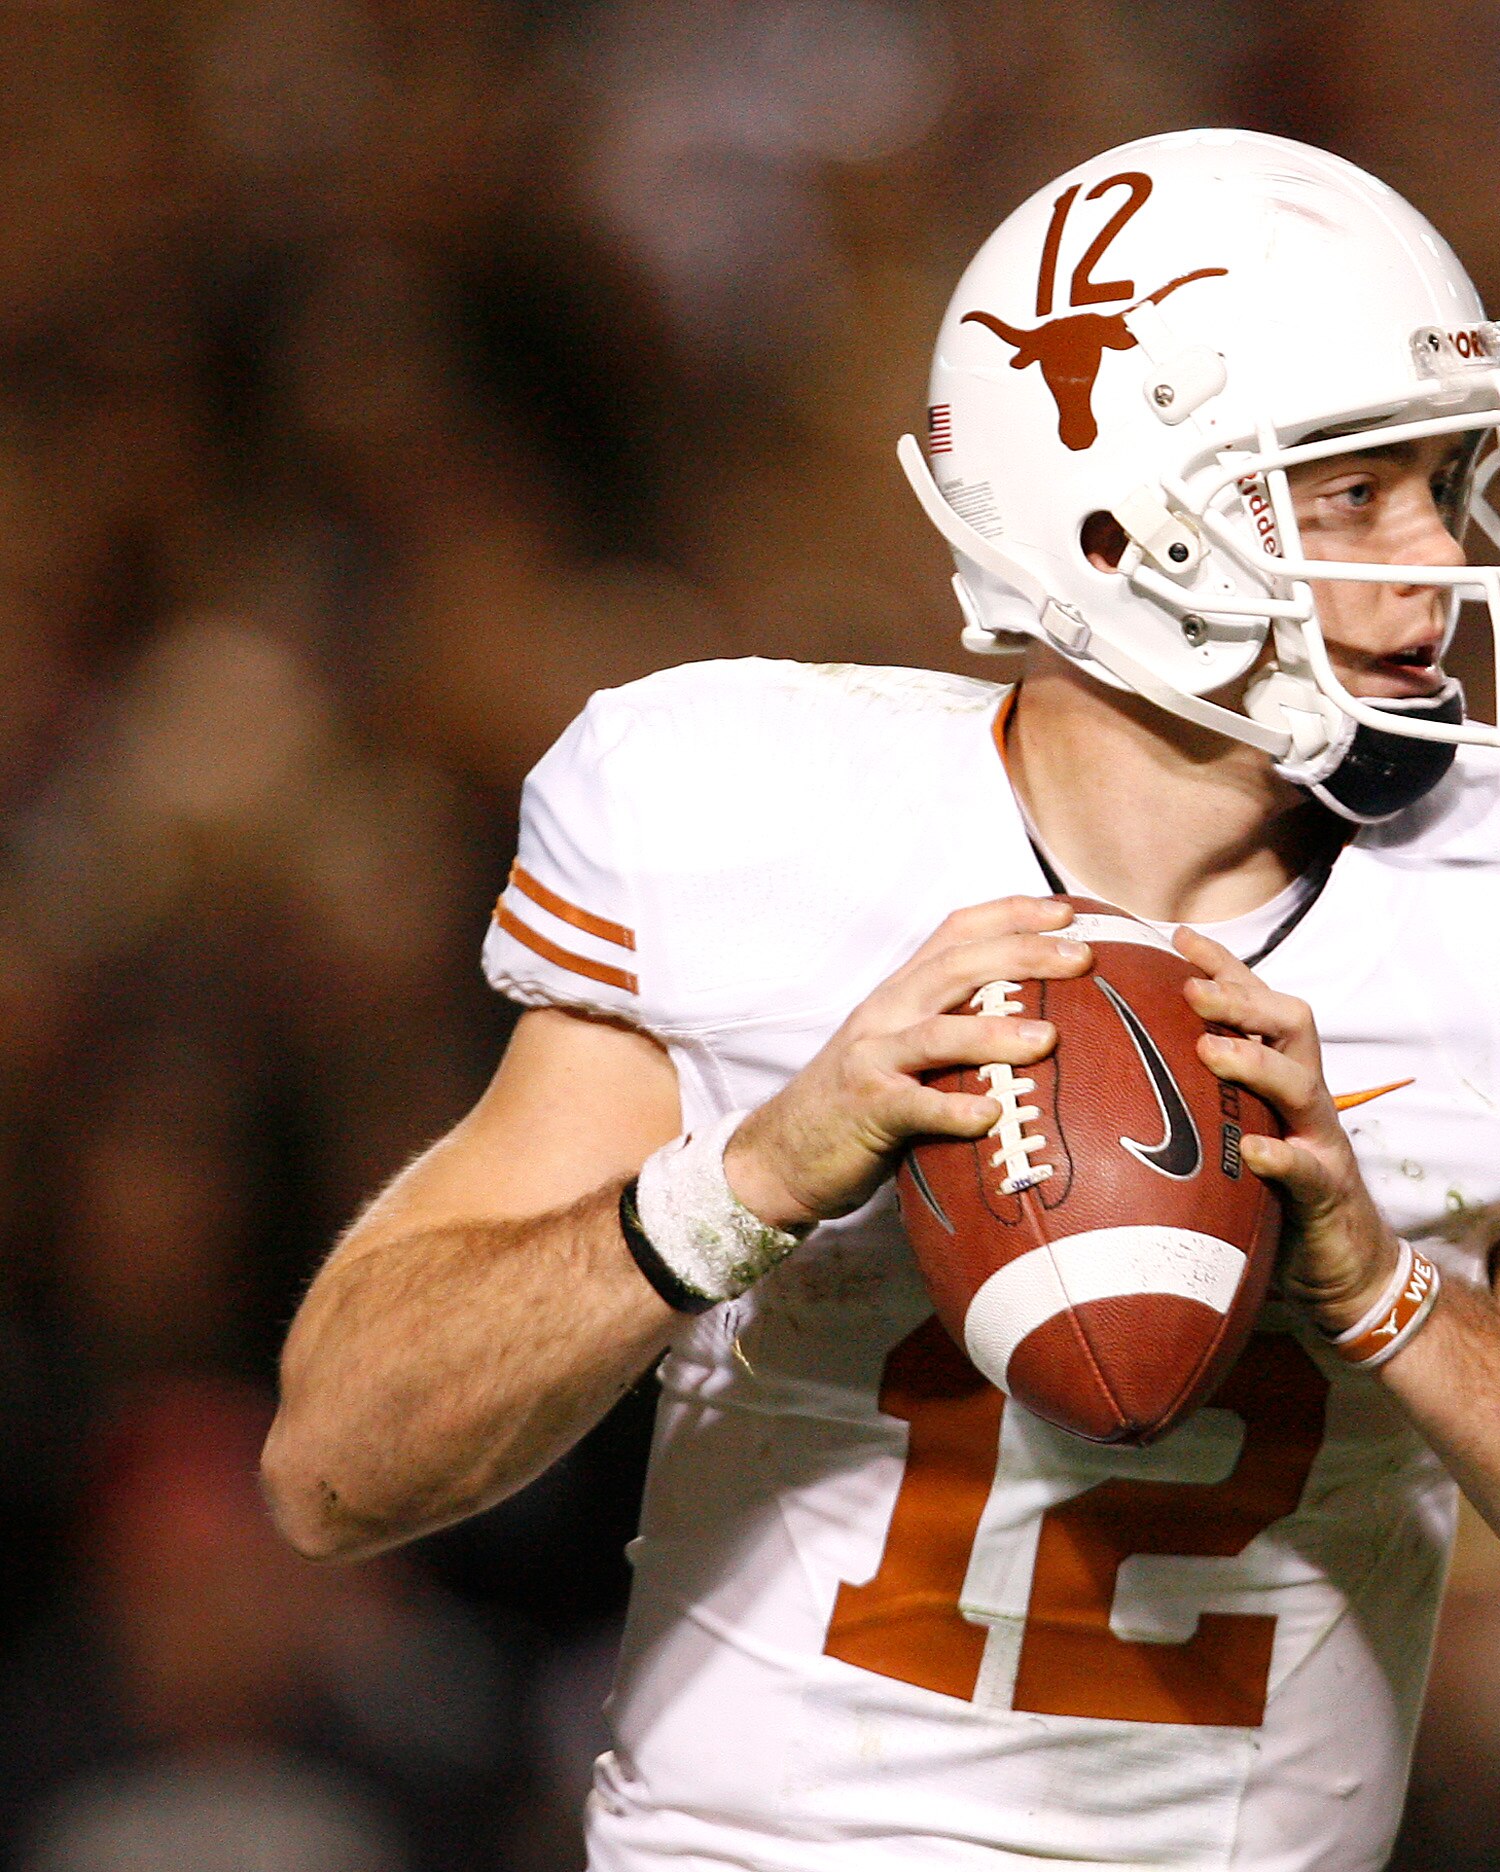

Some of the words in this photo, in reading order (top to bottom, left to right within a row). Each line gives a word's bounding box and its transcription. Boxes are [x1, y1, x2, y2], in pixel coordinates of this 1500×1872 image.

[1036, 171, 1154, 318] 12
[1237, 473, 1277, 554] idde
[1404, 1258, 1431, 1302] WE
[823, 1315, 1331, 1727] 12
